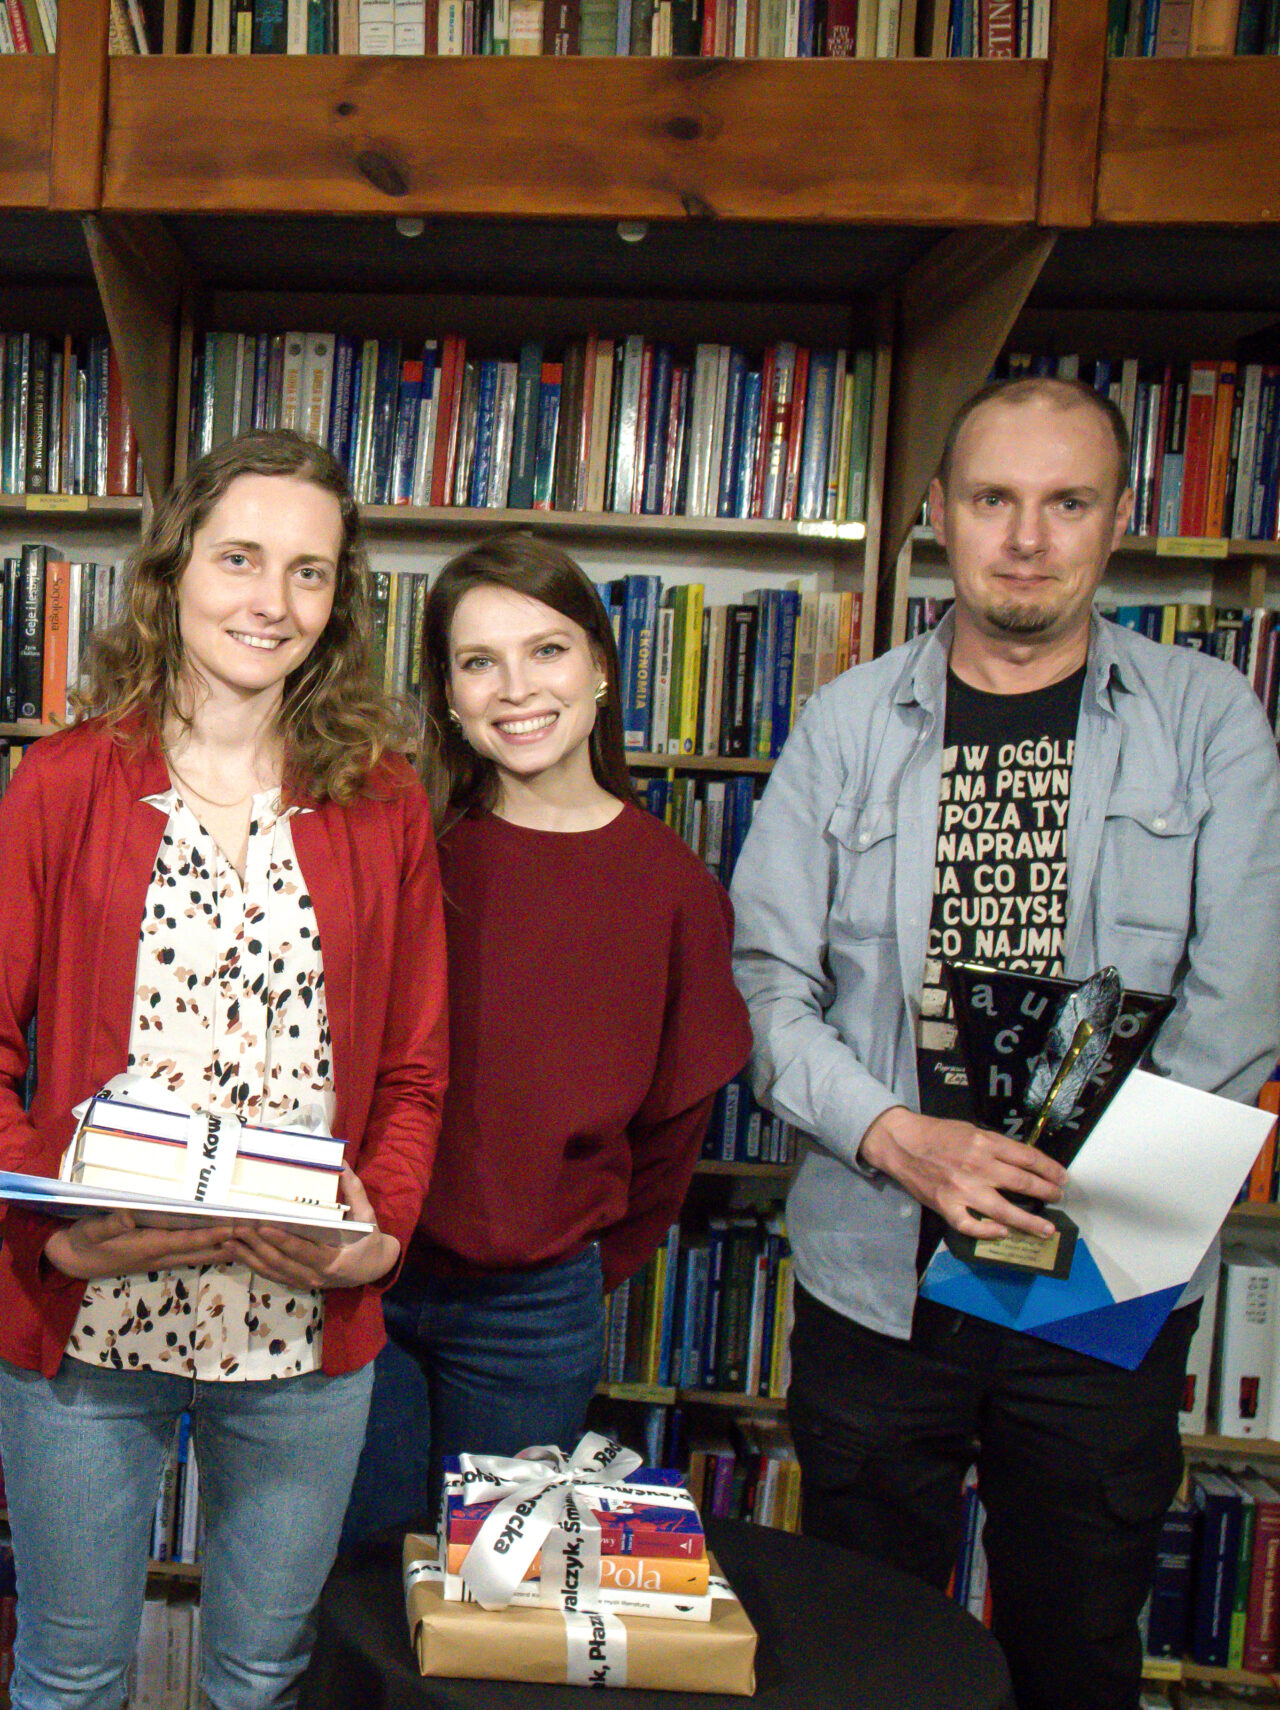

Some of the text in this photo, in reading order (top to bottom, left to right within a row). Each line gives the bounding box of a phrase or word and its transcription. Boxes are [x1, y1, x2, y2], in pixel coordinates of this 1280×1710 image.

[51, 577, 65, 632] Socjologia
[25, 611, 39, 637] Geje
[635, 628, 650, 711] EKONOMIA
[963, 745, 990, 772] W
[954, 769, 1069, 803] NA PEWN
[944, 801, 1021, 832] POZA
[973, 864, 1016, 894] CO
[943, 894, 1065, 926] CUDZYSŁ
[927, 928, 962, 957] CO
[971, 984, 998, 1017] ą
[1020, 991, 1049, 1021] u
[994, 1025, 1024, 1055] ć
[989, 1065, 1013, 1097] h
[599, 1559, 662, 1591] Pola
